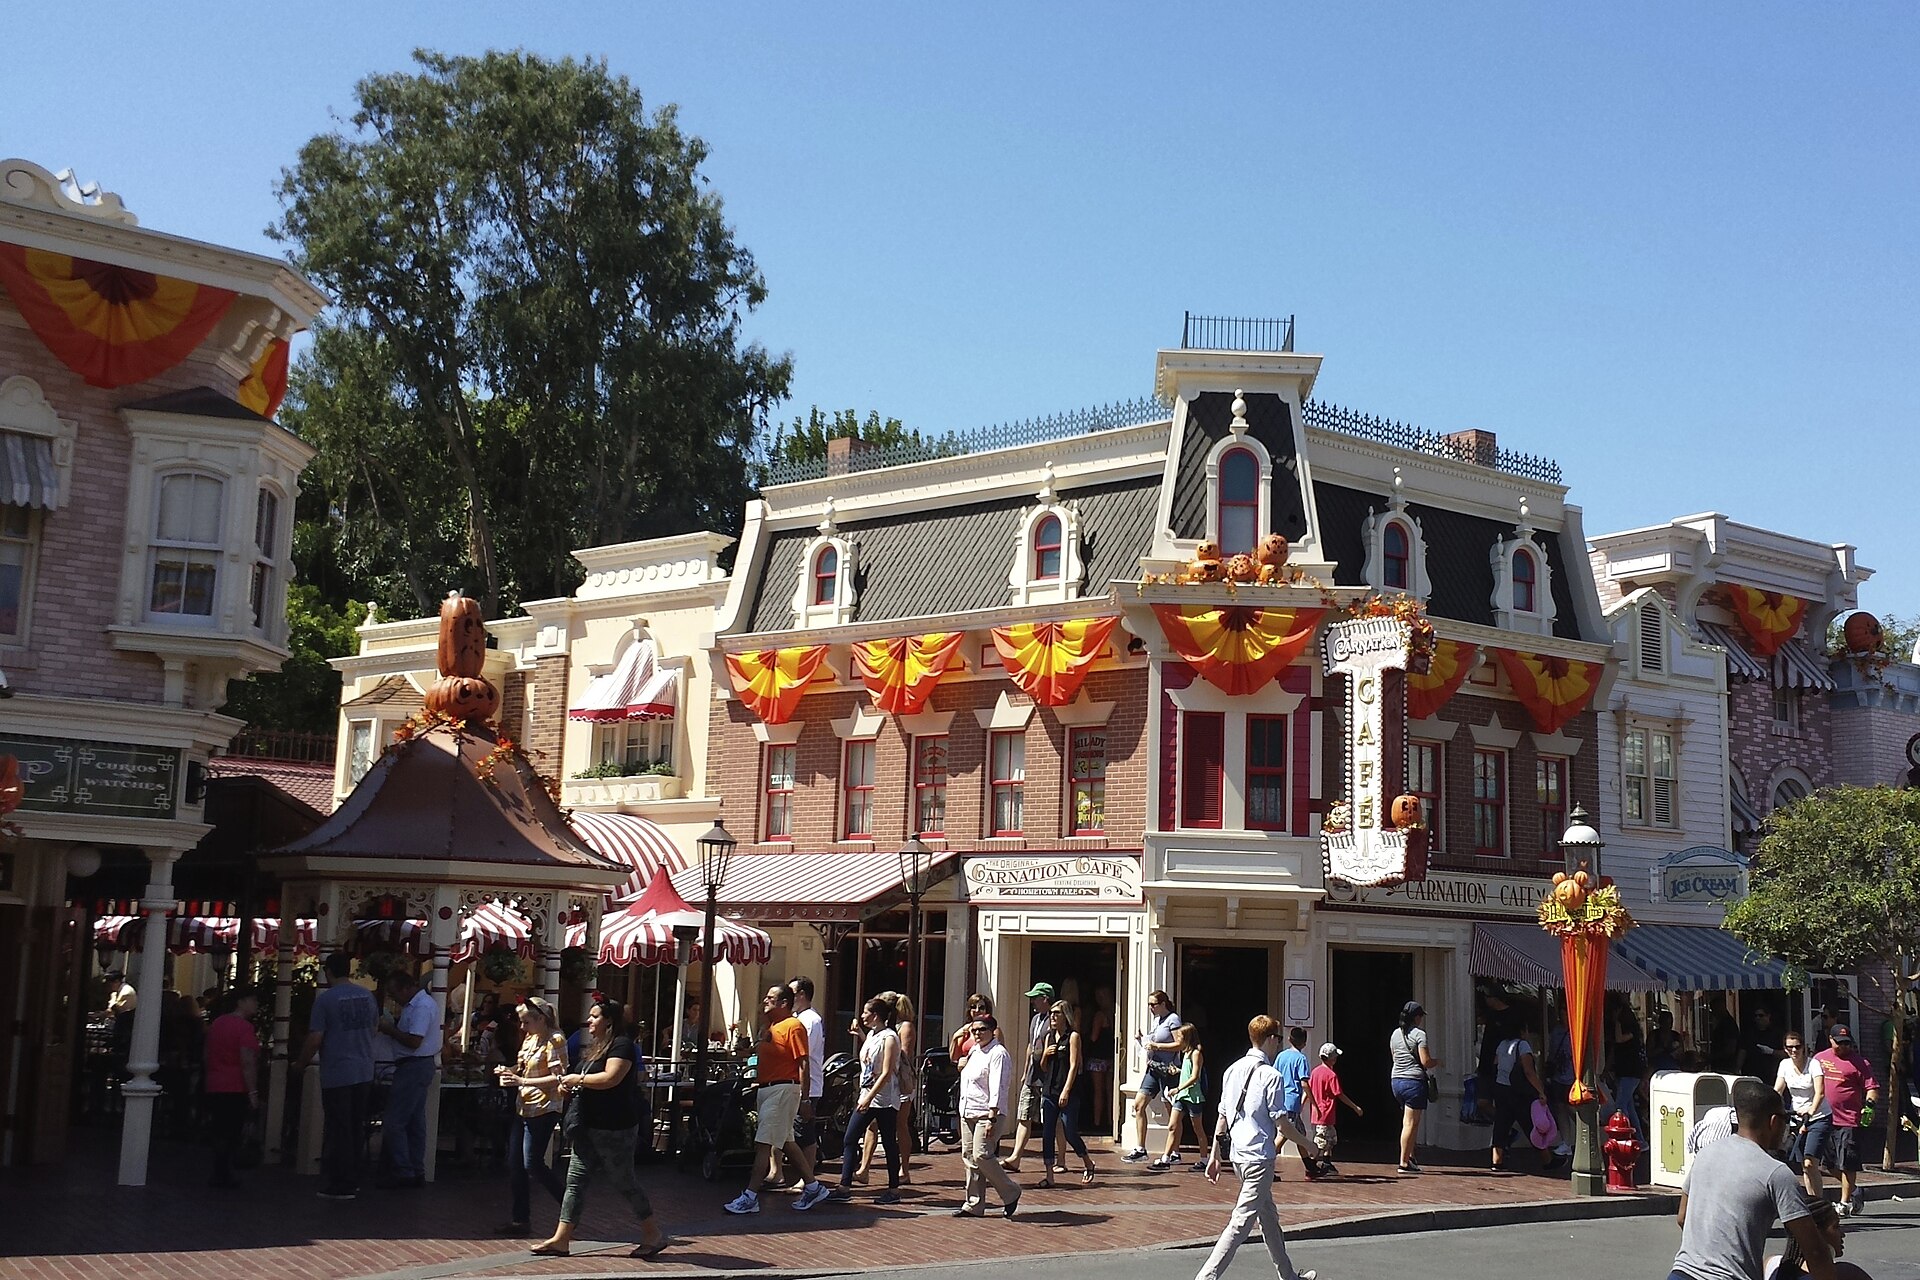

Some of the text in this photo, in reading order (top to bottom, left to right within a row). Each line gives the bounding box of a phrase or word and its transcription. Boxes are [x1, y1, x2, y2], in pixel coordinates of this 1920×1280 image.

[1333, 638, 1401, 661] CARNATION
[95, 761, 158, 774] CURIOS
[84, 778, 166, 791] WATCHES
[1001, 859, 1035, 868] ORIGINAL
[972, 862, 1069, 883] CARNATION
[1018, 888, 1058, 896] HOMETOWN
[1406, 879, 1488, 905] CARNATION
[1671, 876, 1738, 899] ICE CREAM
